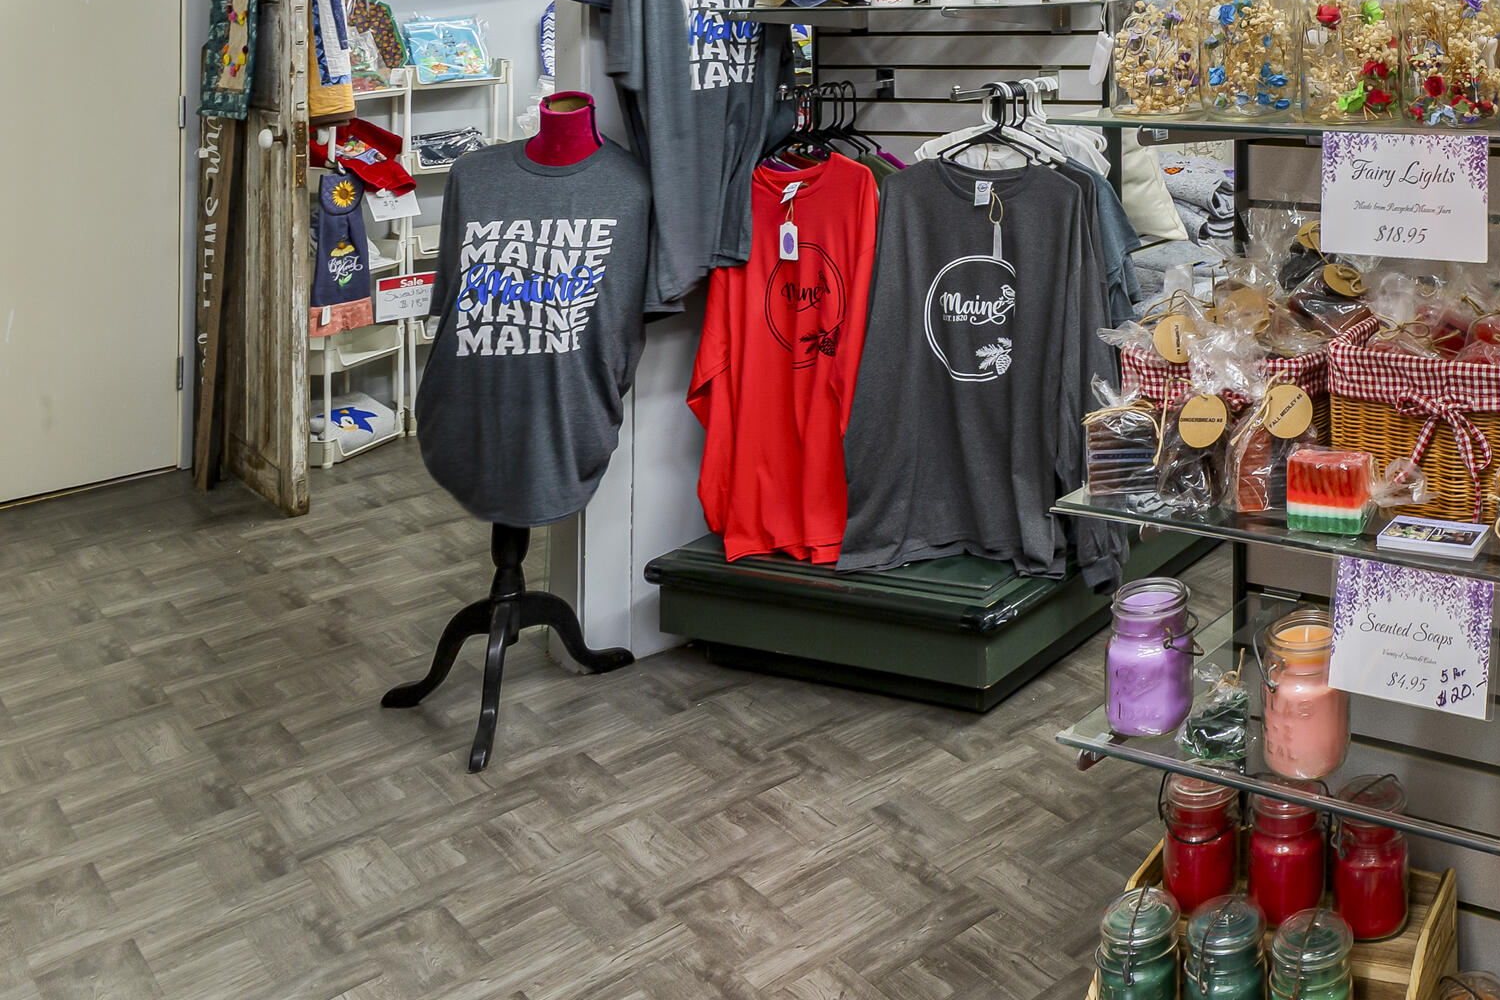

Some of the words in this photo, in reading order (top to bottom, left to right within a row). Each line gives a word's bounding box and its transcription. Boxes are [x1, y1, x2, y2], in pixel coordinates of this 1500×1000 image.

[1351, 158, 1397, 189] Fairy
[1398, 160, 1456, 190] Lights
[462, 218, 618, 248] MAINE
[1373, 225, 1429, 245] $18.95
[460, 240, 612, 279] MAINE
[400, 277, 424, 289] Sale
[456, 263, 605, 312] Maine
[456, 297, 596, 332] MAINE
[939, 291, 1005, 325] Maine
[952, 313, 968, 322] 1820
[1269, 416, 1281, 429] FALL
[1279, 399, 1298, 418] MEDLEY
[1359, 612, 1413, 637] Scented
[1413, 622, 1454, 651] Soaps
[1386, 671, 1429, 693] $4.95
[1440, 668, 1449, 684] 5
